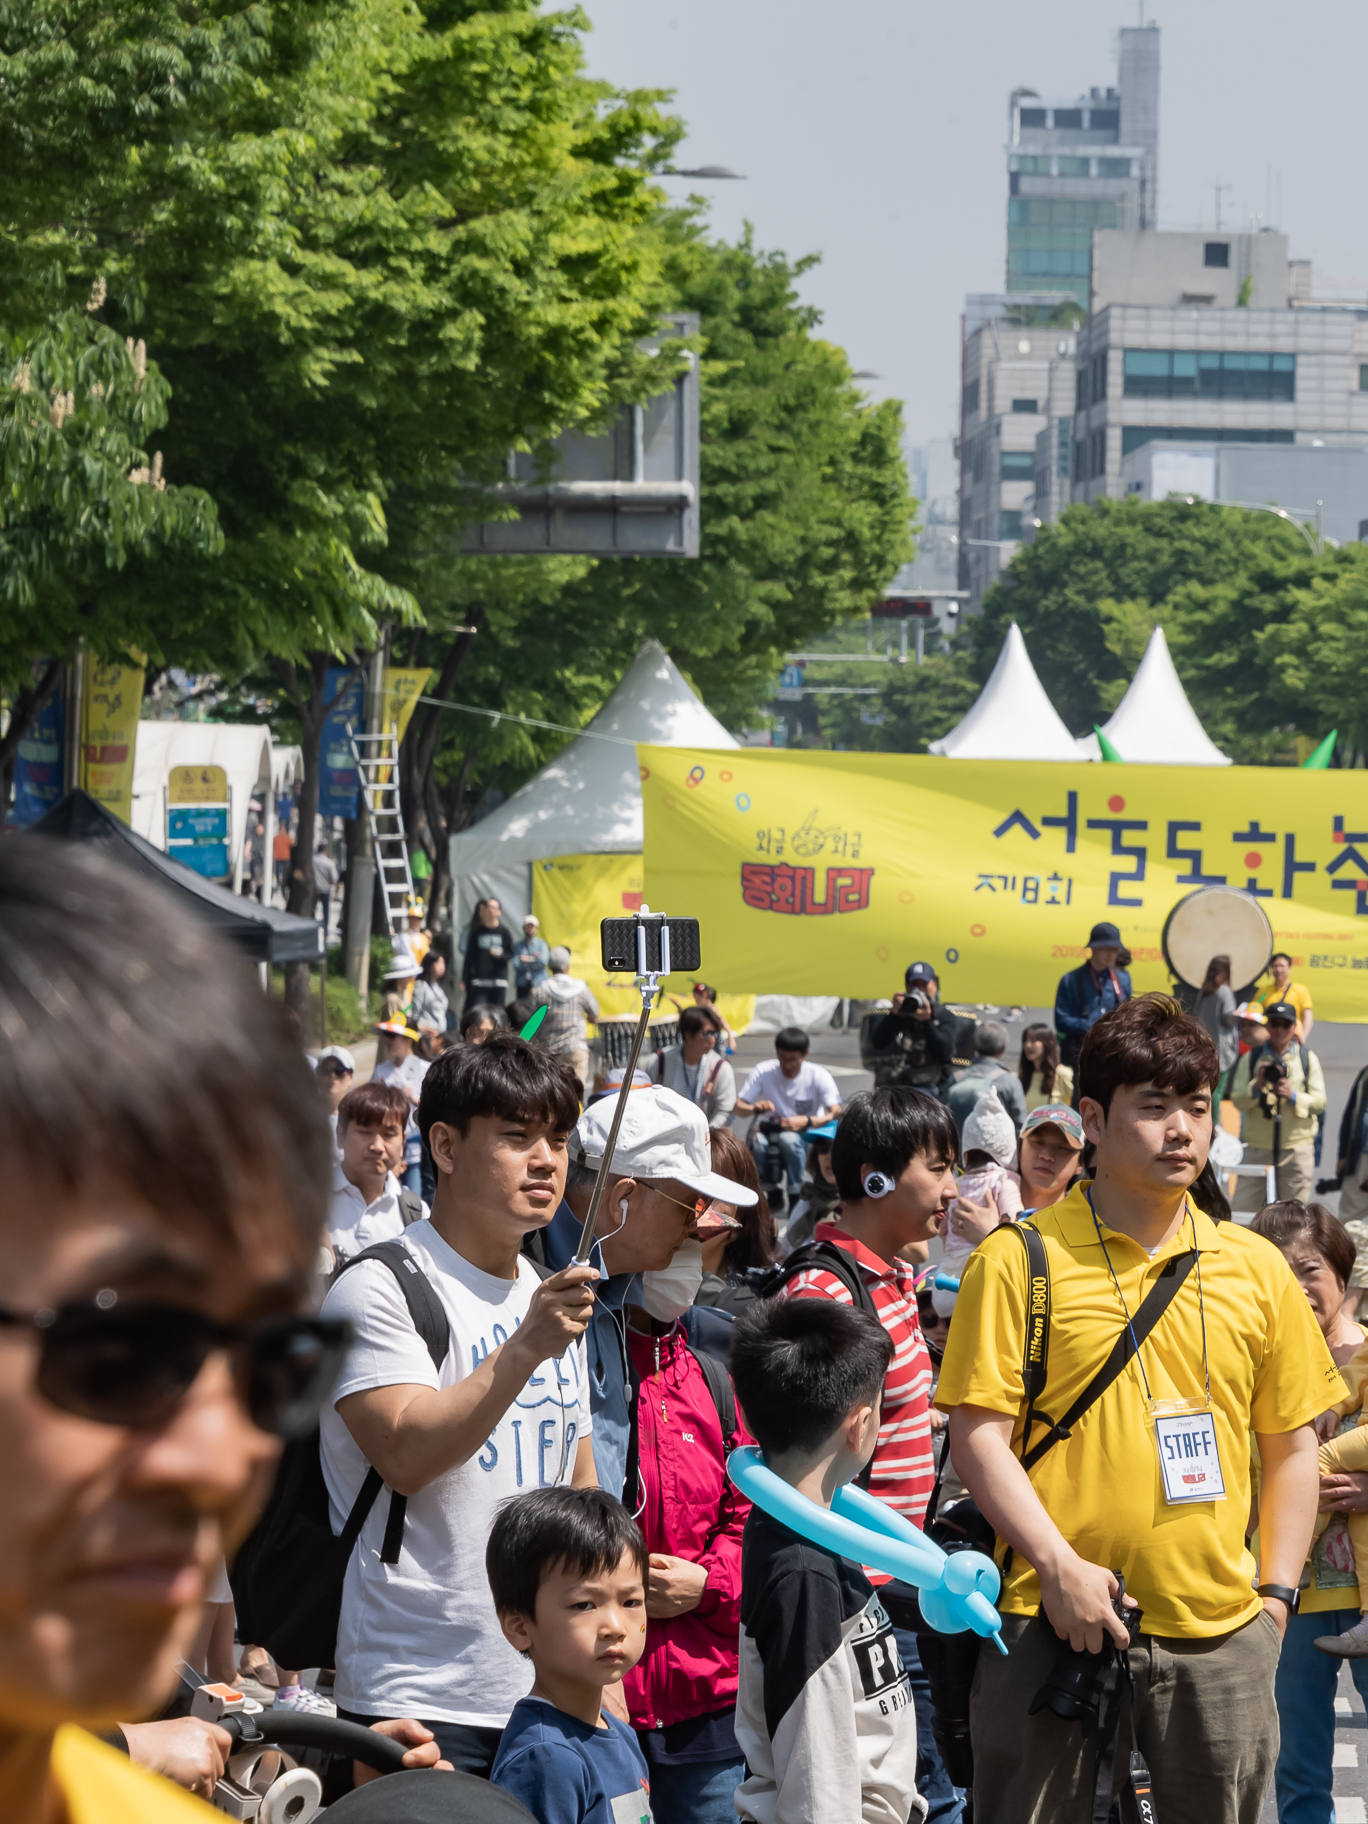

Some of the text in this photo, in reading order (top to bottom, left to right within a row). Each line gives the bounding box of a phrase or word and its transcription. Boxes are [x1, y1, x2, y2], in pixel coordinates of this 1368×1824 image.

[756, 827, 863, 859] 와글 와글
[742, 861, 875, 916] 동화나라
[973, 872, 1073, 906] 제8회
[1029, 1276, 1047, 1363] Nikon D800
[682, 1432, 694, 1443] K2
[1163, 1430, 1211, 1460] STAFF
